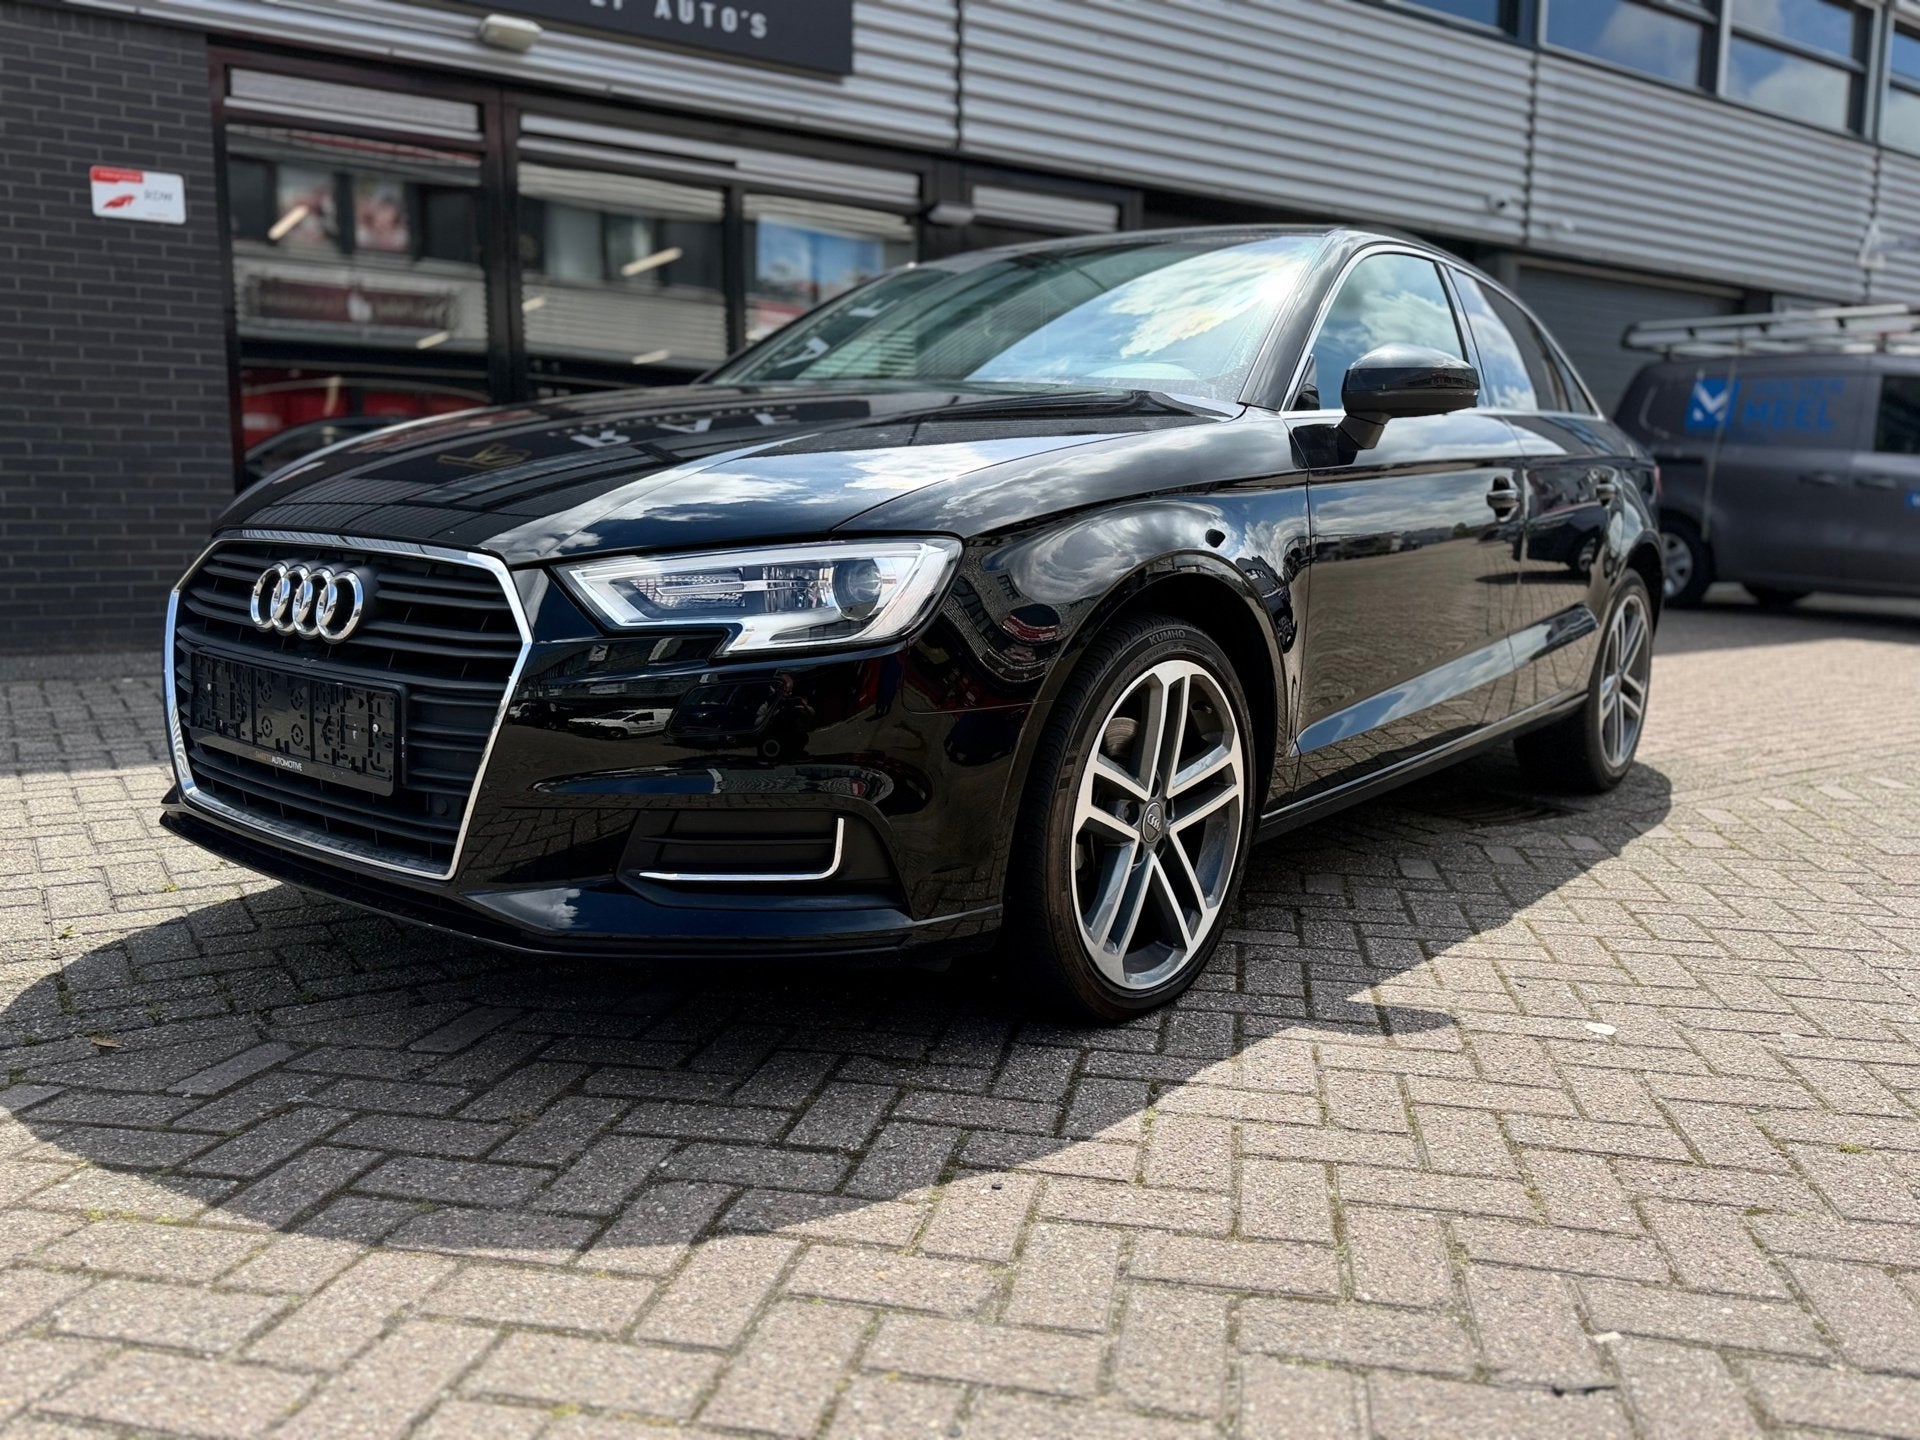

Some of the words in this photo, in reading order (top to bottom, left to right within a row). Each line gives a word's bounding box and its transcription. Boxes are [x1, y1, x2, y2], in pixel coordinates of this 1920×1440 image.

[654, 0, 768, 38] AUTO'S
[1742, 399, 1834, 431] MEEL
[1149, 629, 1186, 645] KUMHO
[271, 755, 303, 772] AUTOMOTIVE
